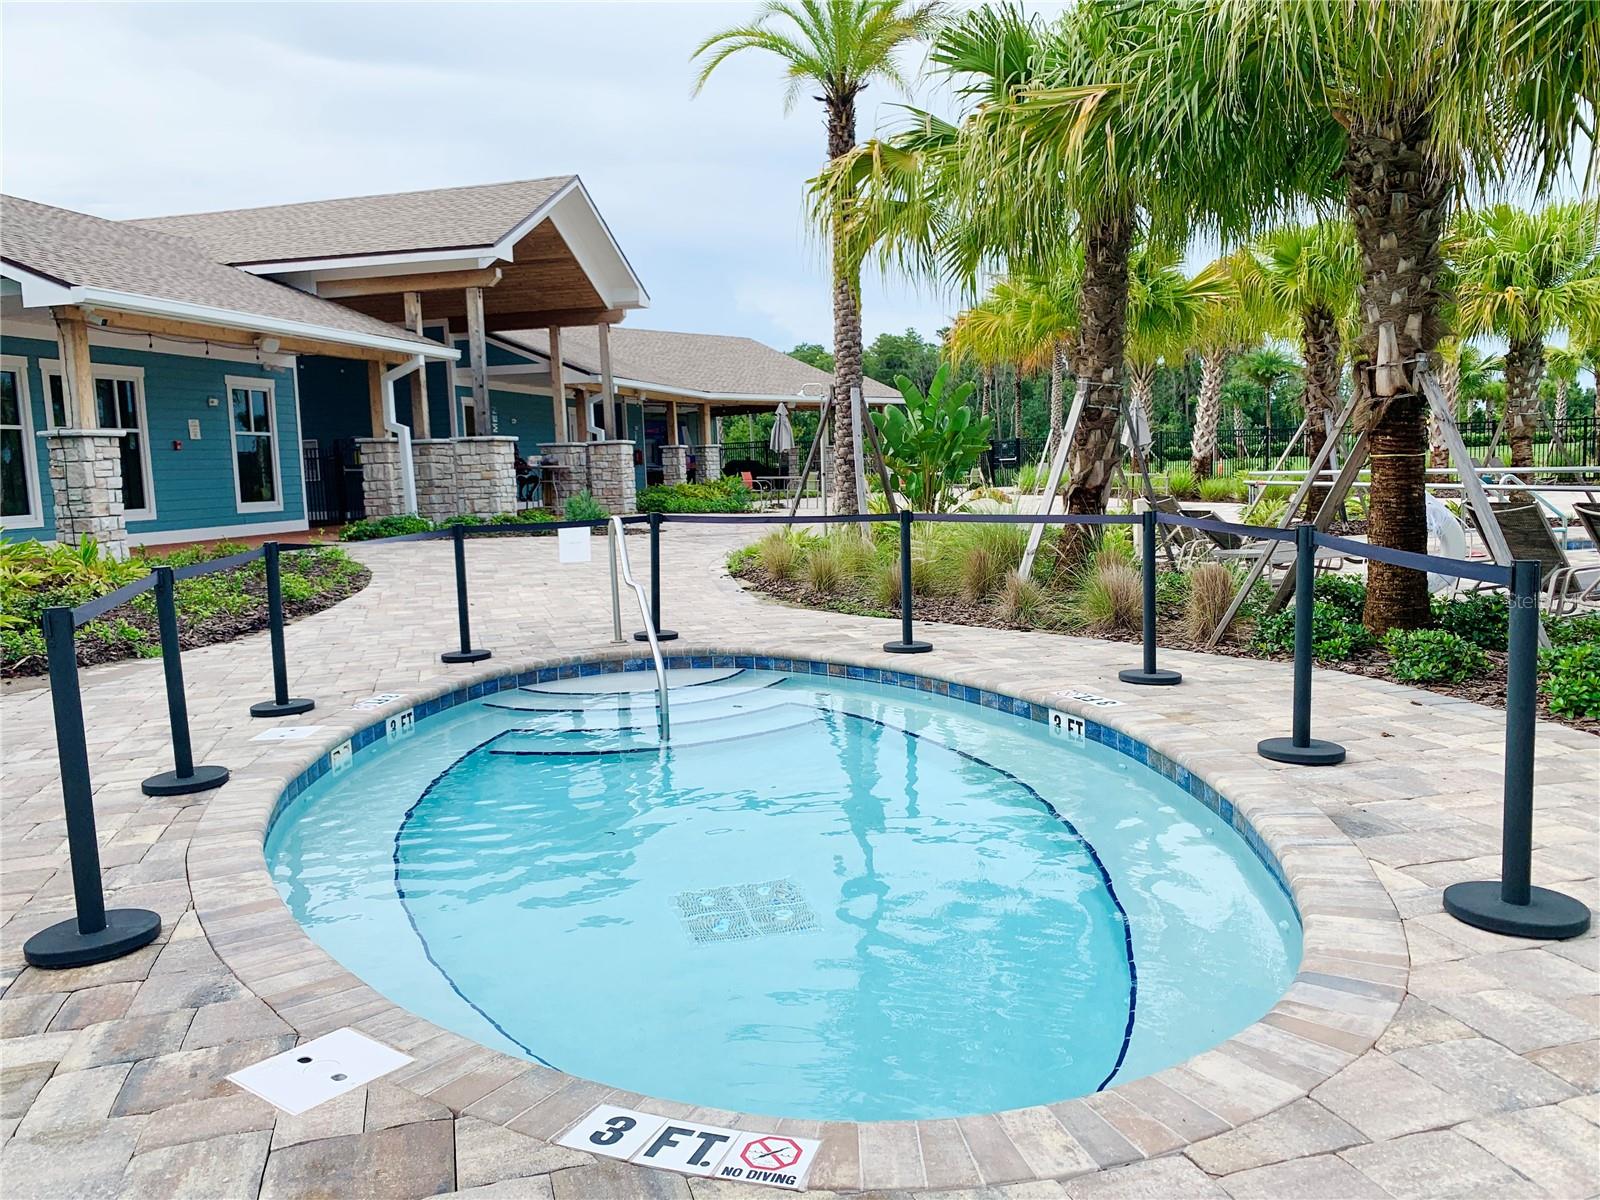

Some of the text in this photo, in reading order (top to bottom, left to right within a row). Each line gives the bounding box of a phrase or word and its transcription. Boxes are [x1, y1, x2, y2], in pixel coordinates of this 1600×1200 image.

[400, 712, 413, 728] FT
[1067, 718, 1084, 735] FT
[589, 1116, 730, 1167] 3 FT.
[721, 1166, 797, 1185] NO DIVING
